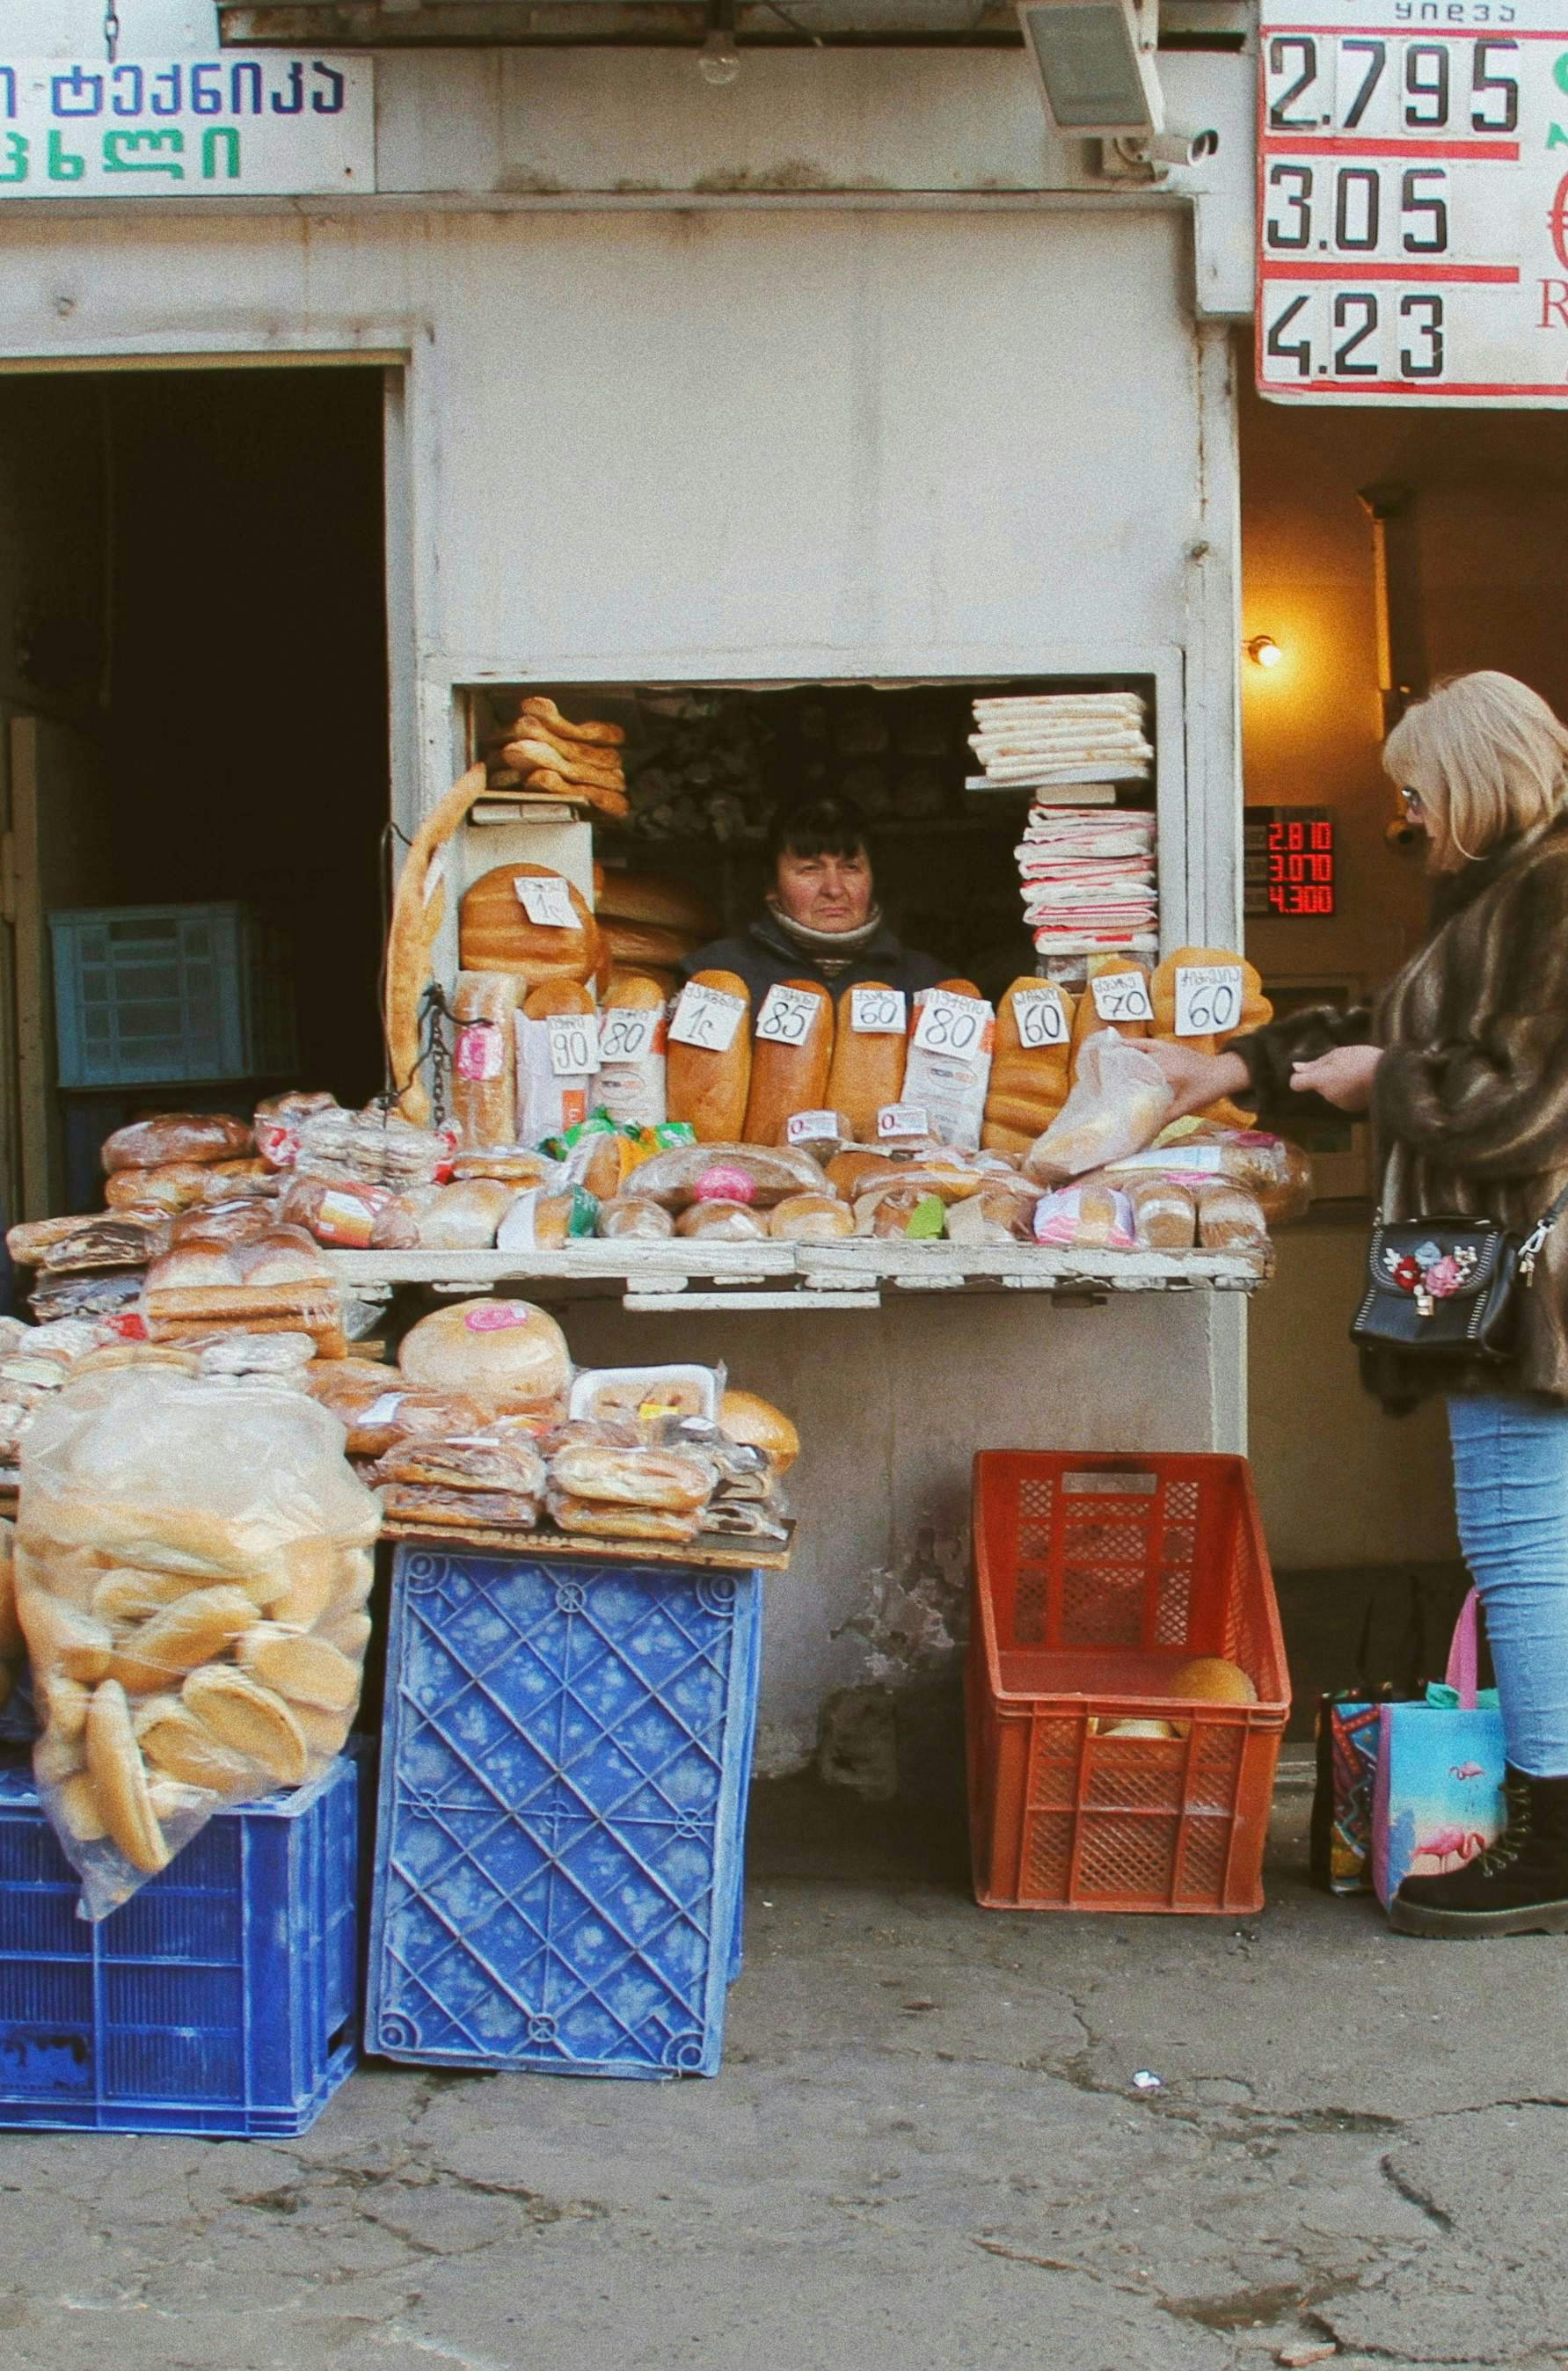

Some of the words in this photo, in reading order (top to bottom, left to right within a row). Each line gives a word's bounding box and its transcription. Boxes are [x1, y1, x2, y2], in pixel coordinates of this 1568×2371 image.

[51, 61, 344, 117] ტექნიკა
[1270, 37, 1519, 132] 2.795
[1267, 164, 1448, 253] 3.05
[1267, 293, 1443, 378] 4.23
[763, 1002, 814, 1038] 85
[860, 1001, 897, 1024] 60
[1025, 1004, 1061, 1043] 60
[1103, 991, 1147, 1017] 70
[1188, 986, 1233, 1027] 60
[603, 1022, 645, 1055] 80
[926, 1008, 976, 1048] 80
[554, 1032, 587, 1069] 90
